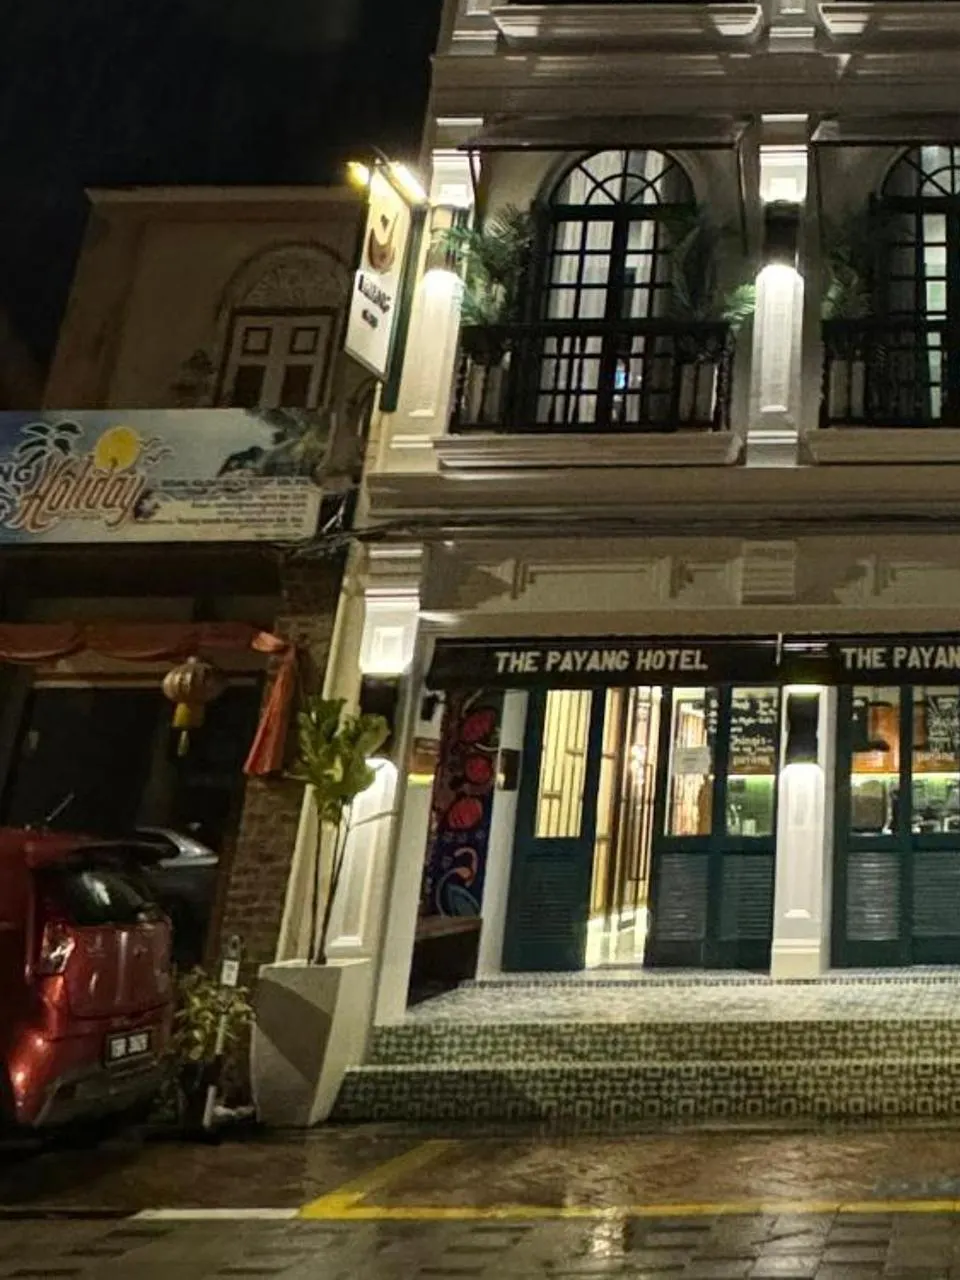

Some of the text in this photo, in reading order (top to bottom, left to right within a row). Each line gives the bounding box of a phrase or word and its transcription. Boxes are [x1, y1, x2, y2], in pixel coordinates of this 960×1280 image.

[5, 453, 147, 533] Holiday
[495, 649, 709, 673] THE PAYANG HOTEL
[840, 647, 888, 670] THE
